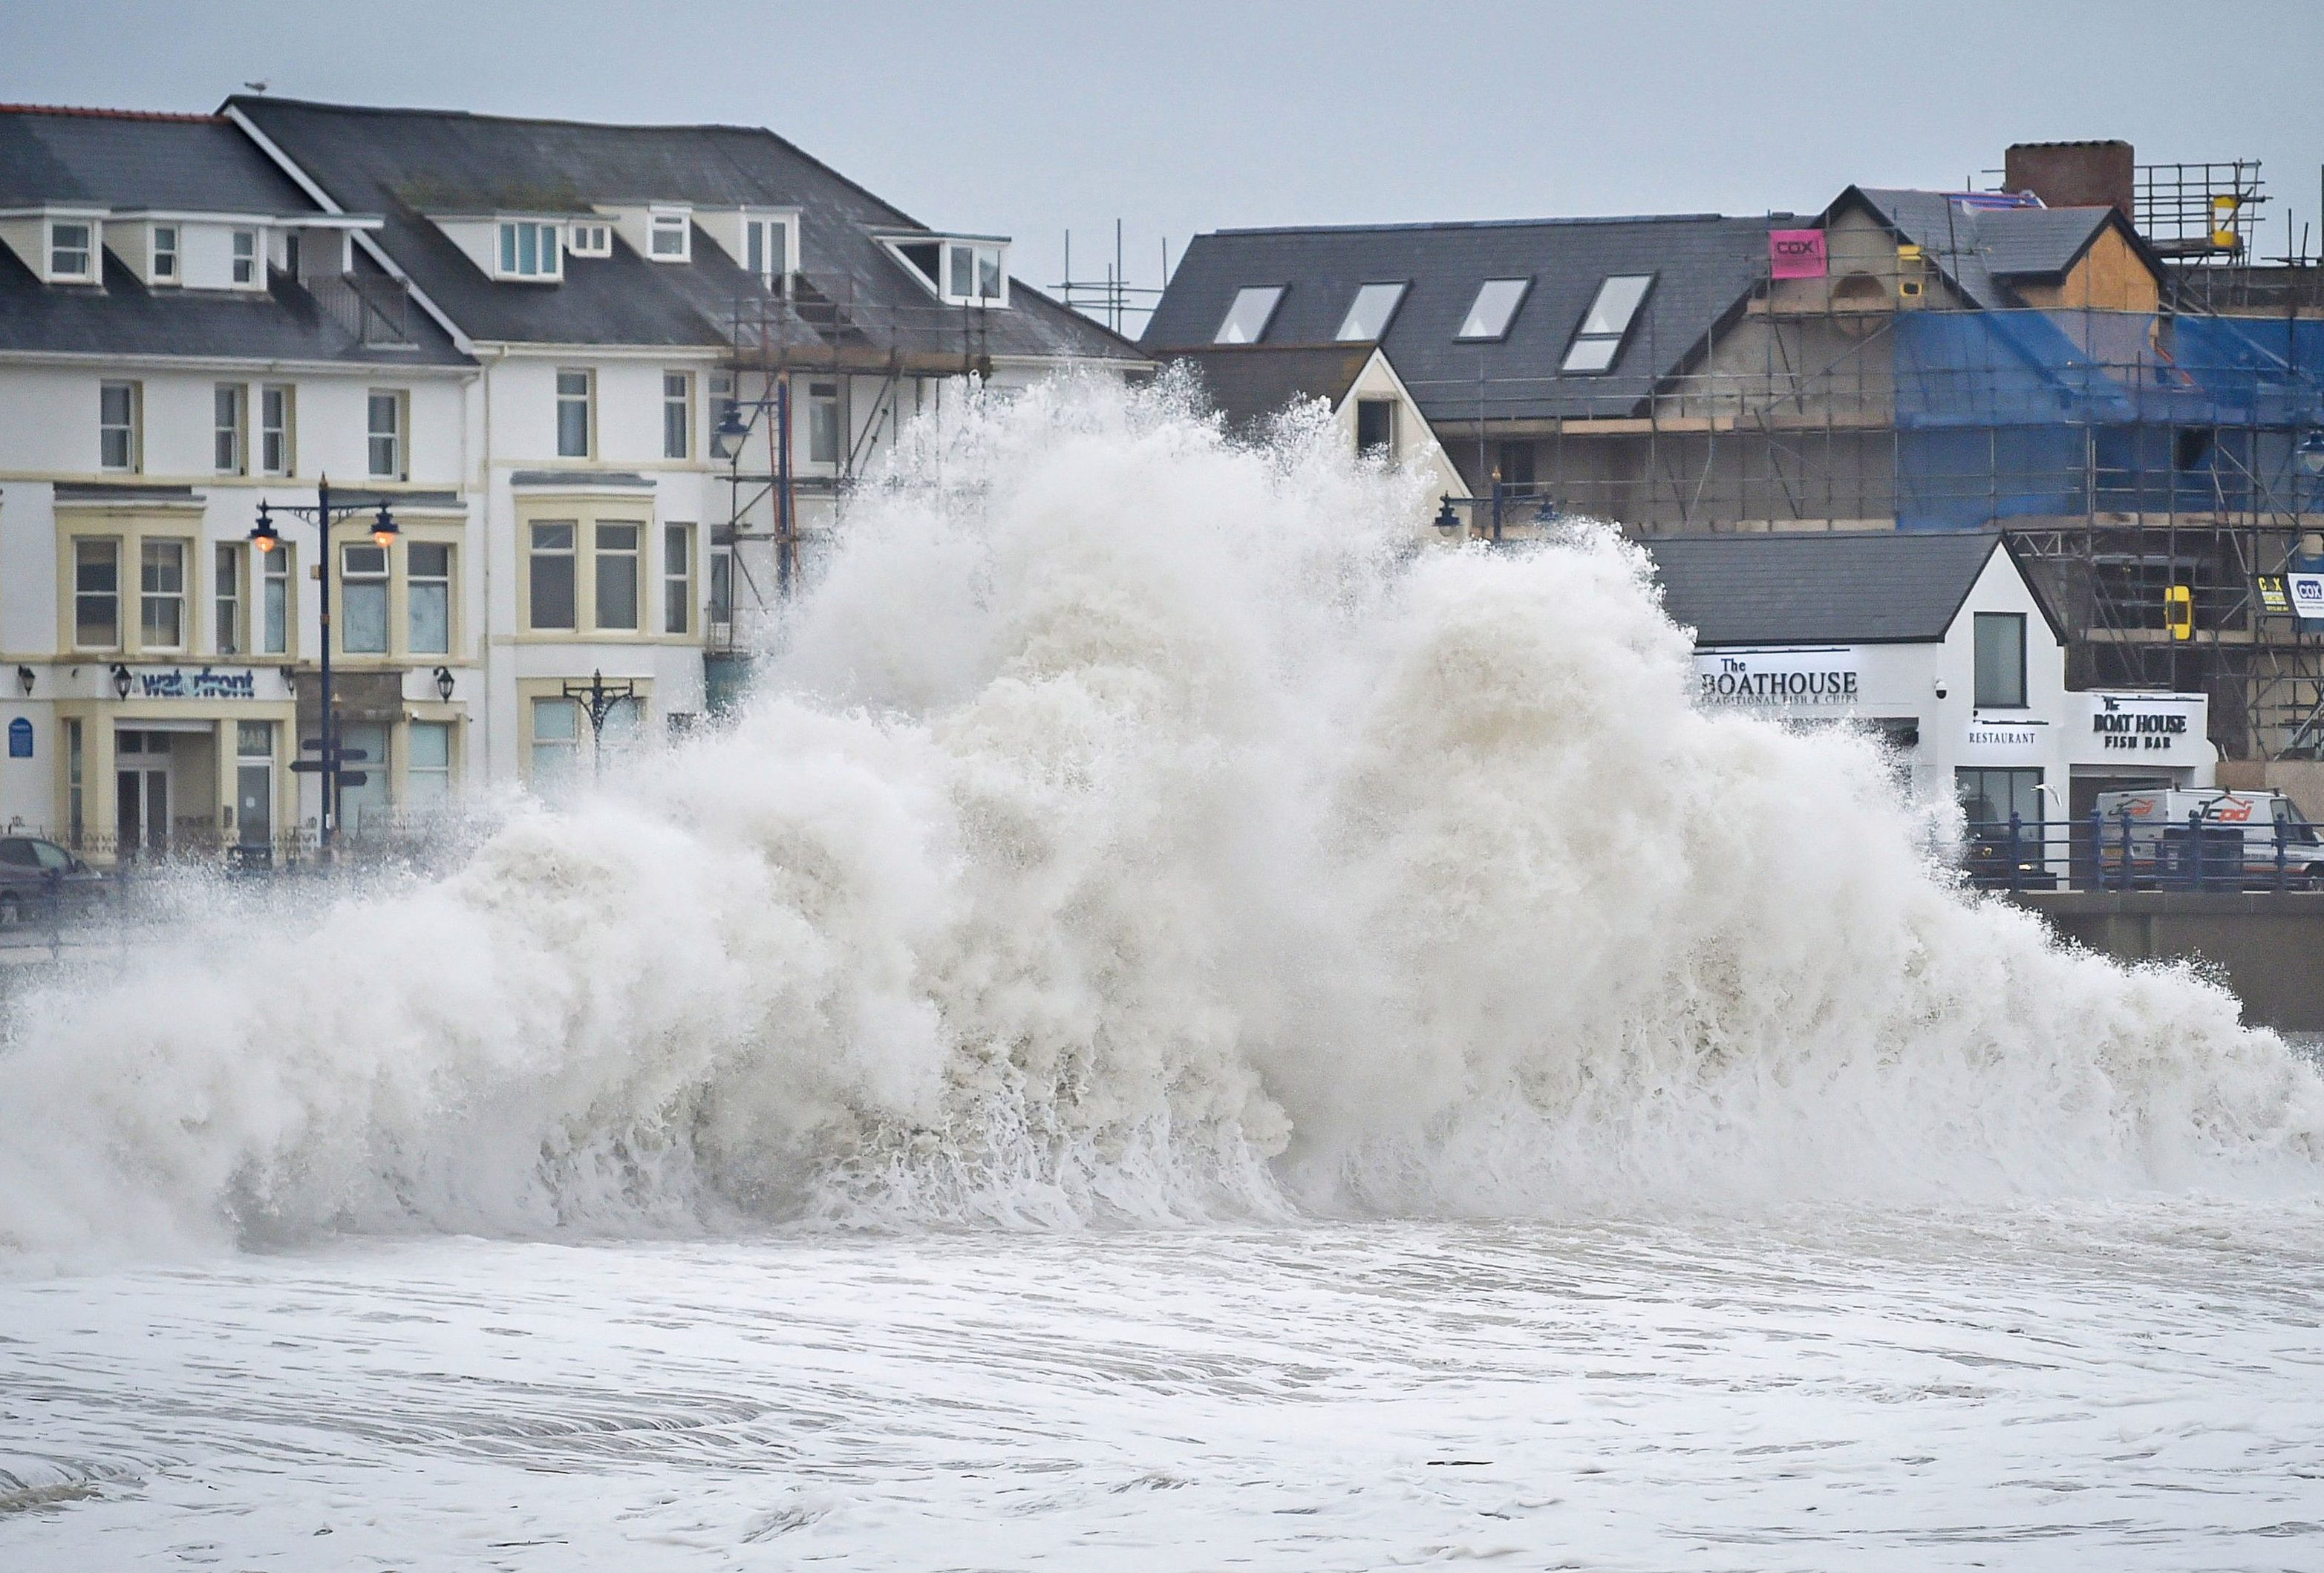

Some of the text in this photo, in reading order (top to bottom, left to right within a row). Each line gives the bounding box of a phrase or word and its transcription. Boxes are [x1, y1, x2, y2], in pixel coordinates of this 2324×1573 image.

[2258, 577, 2282, 592] CX
[2299, 584, 2322, 599] COX
[1721, 658, 1746, 672] The
[1701, 672, 1858, 696] BOATHOUSE
[1783, 695, 1807, 704] FISH
[2094, 714, 2187, 733] BOAT HOUSE
[1969, 732, 2035, 744] RESTAURANT
[2105, 736, 2170, 749] FISH BAR
